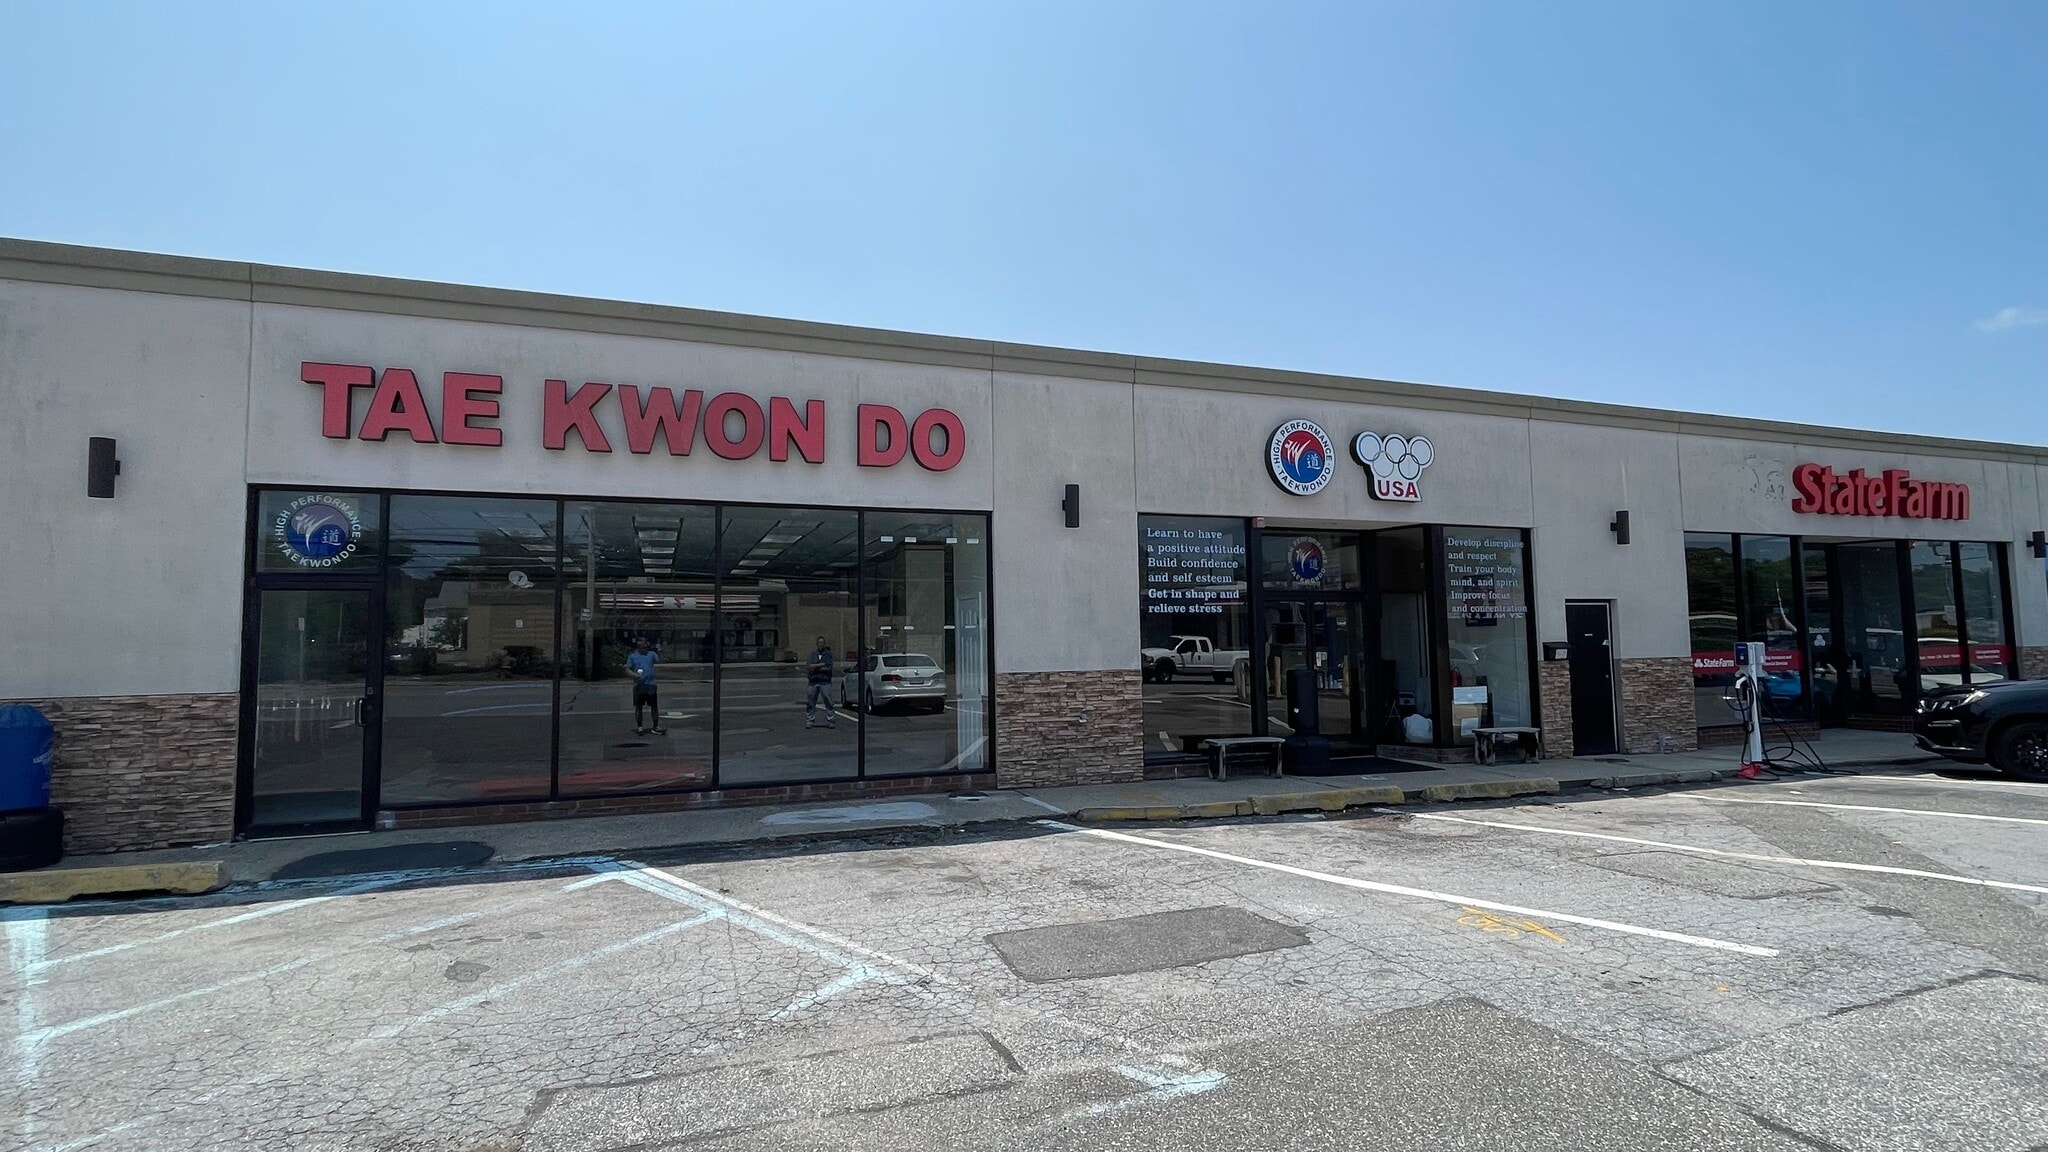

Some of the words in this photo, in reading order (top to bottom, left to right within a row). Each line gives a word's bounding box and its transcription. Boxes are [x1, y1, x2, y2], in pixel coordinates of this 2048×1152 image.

[301, 361, 502, 446] TAE
[543, 379, 825, 464] KWON
[857, 403, 966, 471] DO
[1273, 439, 1282, 464] HIGH
[1280, 422, 1332, 461] PERFORMANCE
[1278, 467, 1331, 492] TAEKWONDO
[1377, 480, 1419, 498] USA
[275, 509, 291, 536] HIGH
[290, 494, 361, 538] PERFORMANCE
[1147, 527, 1179, 538] Learn
[1183, 529, 1194, 538] to
[1198, 529, 1223, 539] have
[1147, 544, 1154, 552] a
[1158, 543, 1200, 554] positive
[1204, 544, 1246, 554] attitude
[1447, 537, 1481, 549] Develop
[1484, 539, 1524, 549] discipline
[278, 541, 356, 568] TAEKWONDO
[1448, 551, 1464, 560] and
[1467, 552, 1497, 561] respect
[1147, 557, 1177, 567] Build
[1181, 558, 1238, 568] confidence
[1448, 563, 1472, 573] Train
[1475, 566, 1494, 575] your
[1148, 572, 1169, 582] and
[1172, 572, 1192, 582] self
[1195, 574, 1232, 583] esteem
[1450, 577, 1475, 586] mind,
[1477, 577, 1494, 586] and
[1496, 579, 1518, 588] spirit
[1148, 588, 1169, 598] Get
[1171, 589, 1182, 598] in
[1185, 589, 1217, 601] shape
[1220, 589, 1240, 599] and
[1451, 590, 1487, 601] Improve
[1488, 590, 1511, 600] focus
[1148, 603, 1186, 613] relieve
[1188, 604, 1223, 613] stress
[1451, 604, 1468, 612] and
[1470, 604, 1528, 613] concentration
